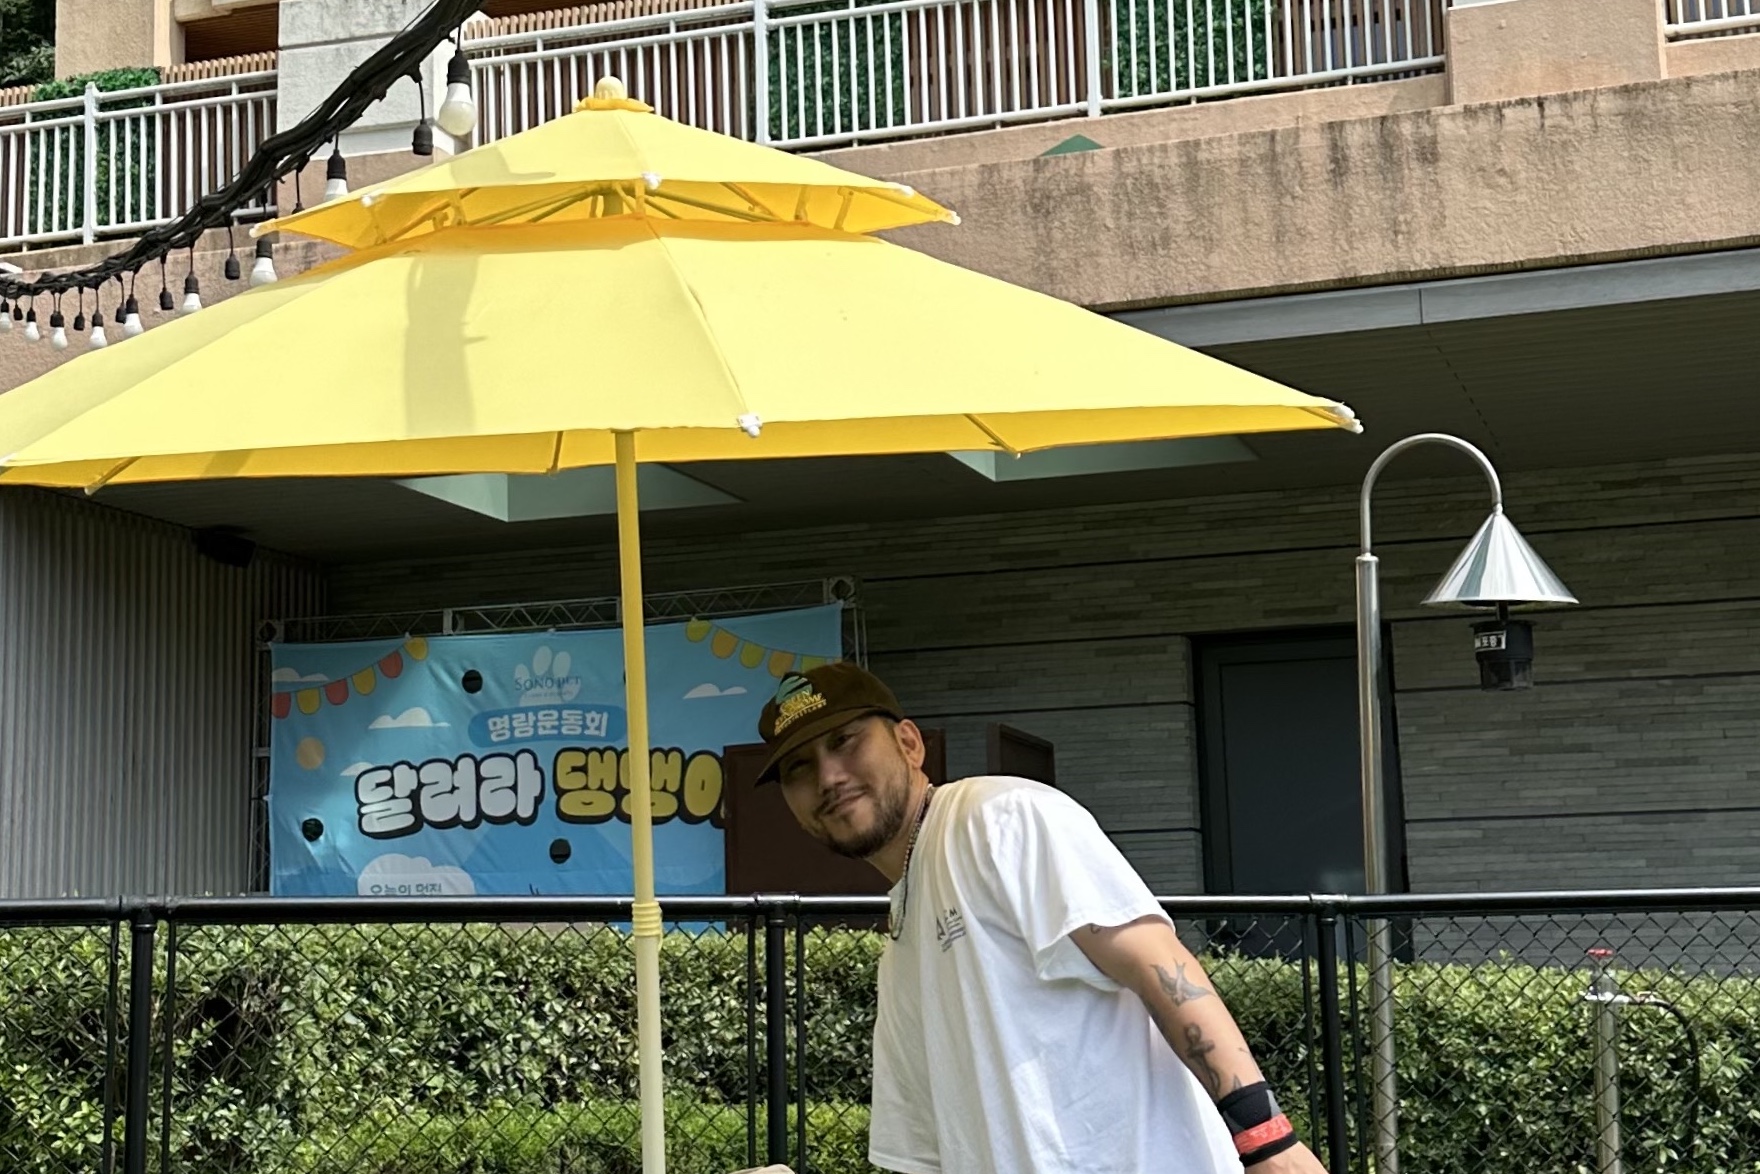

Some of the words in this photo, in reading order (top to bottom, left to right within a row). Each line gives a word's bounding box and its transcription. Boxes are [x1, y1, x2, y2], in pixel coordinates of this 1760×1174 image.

[514, 676, 554, 691] SONO
[486, 709, 608, 742] 명랑운동회
[356, 748, 543, 836] 달려라
